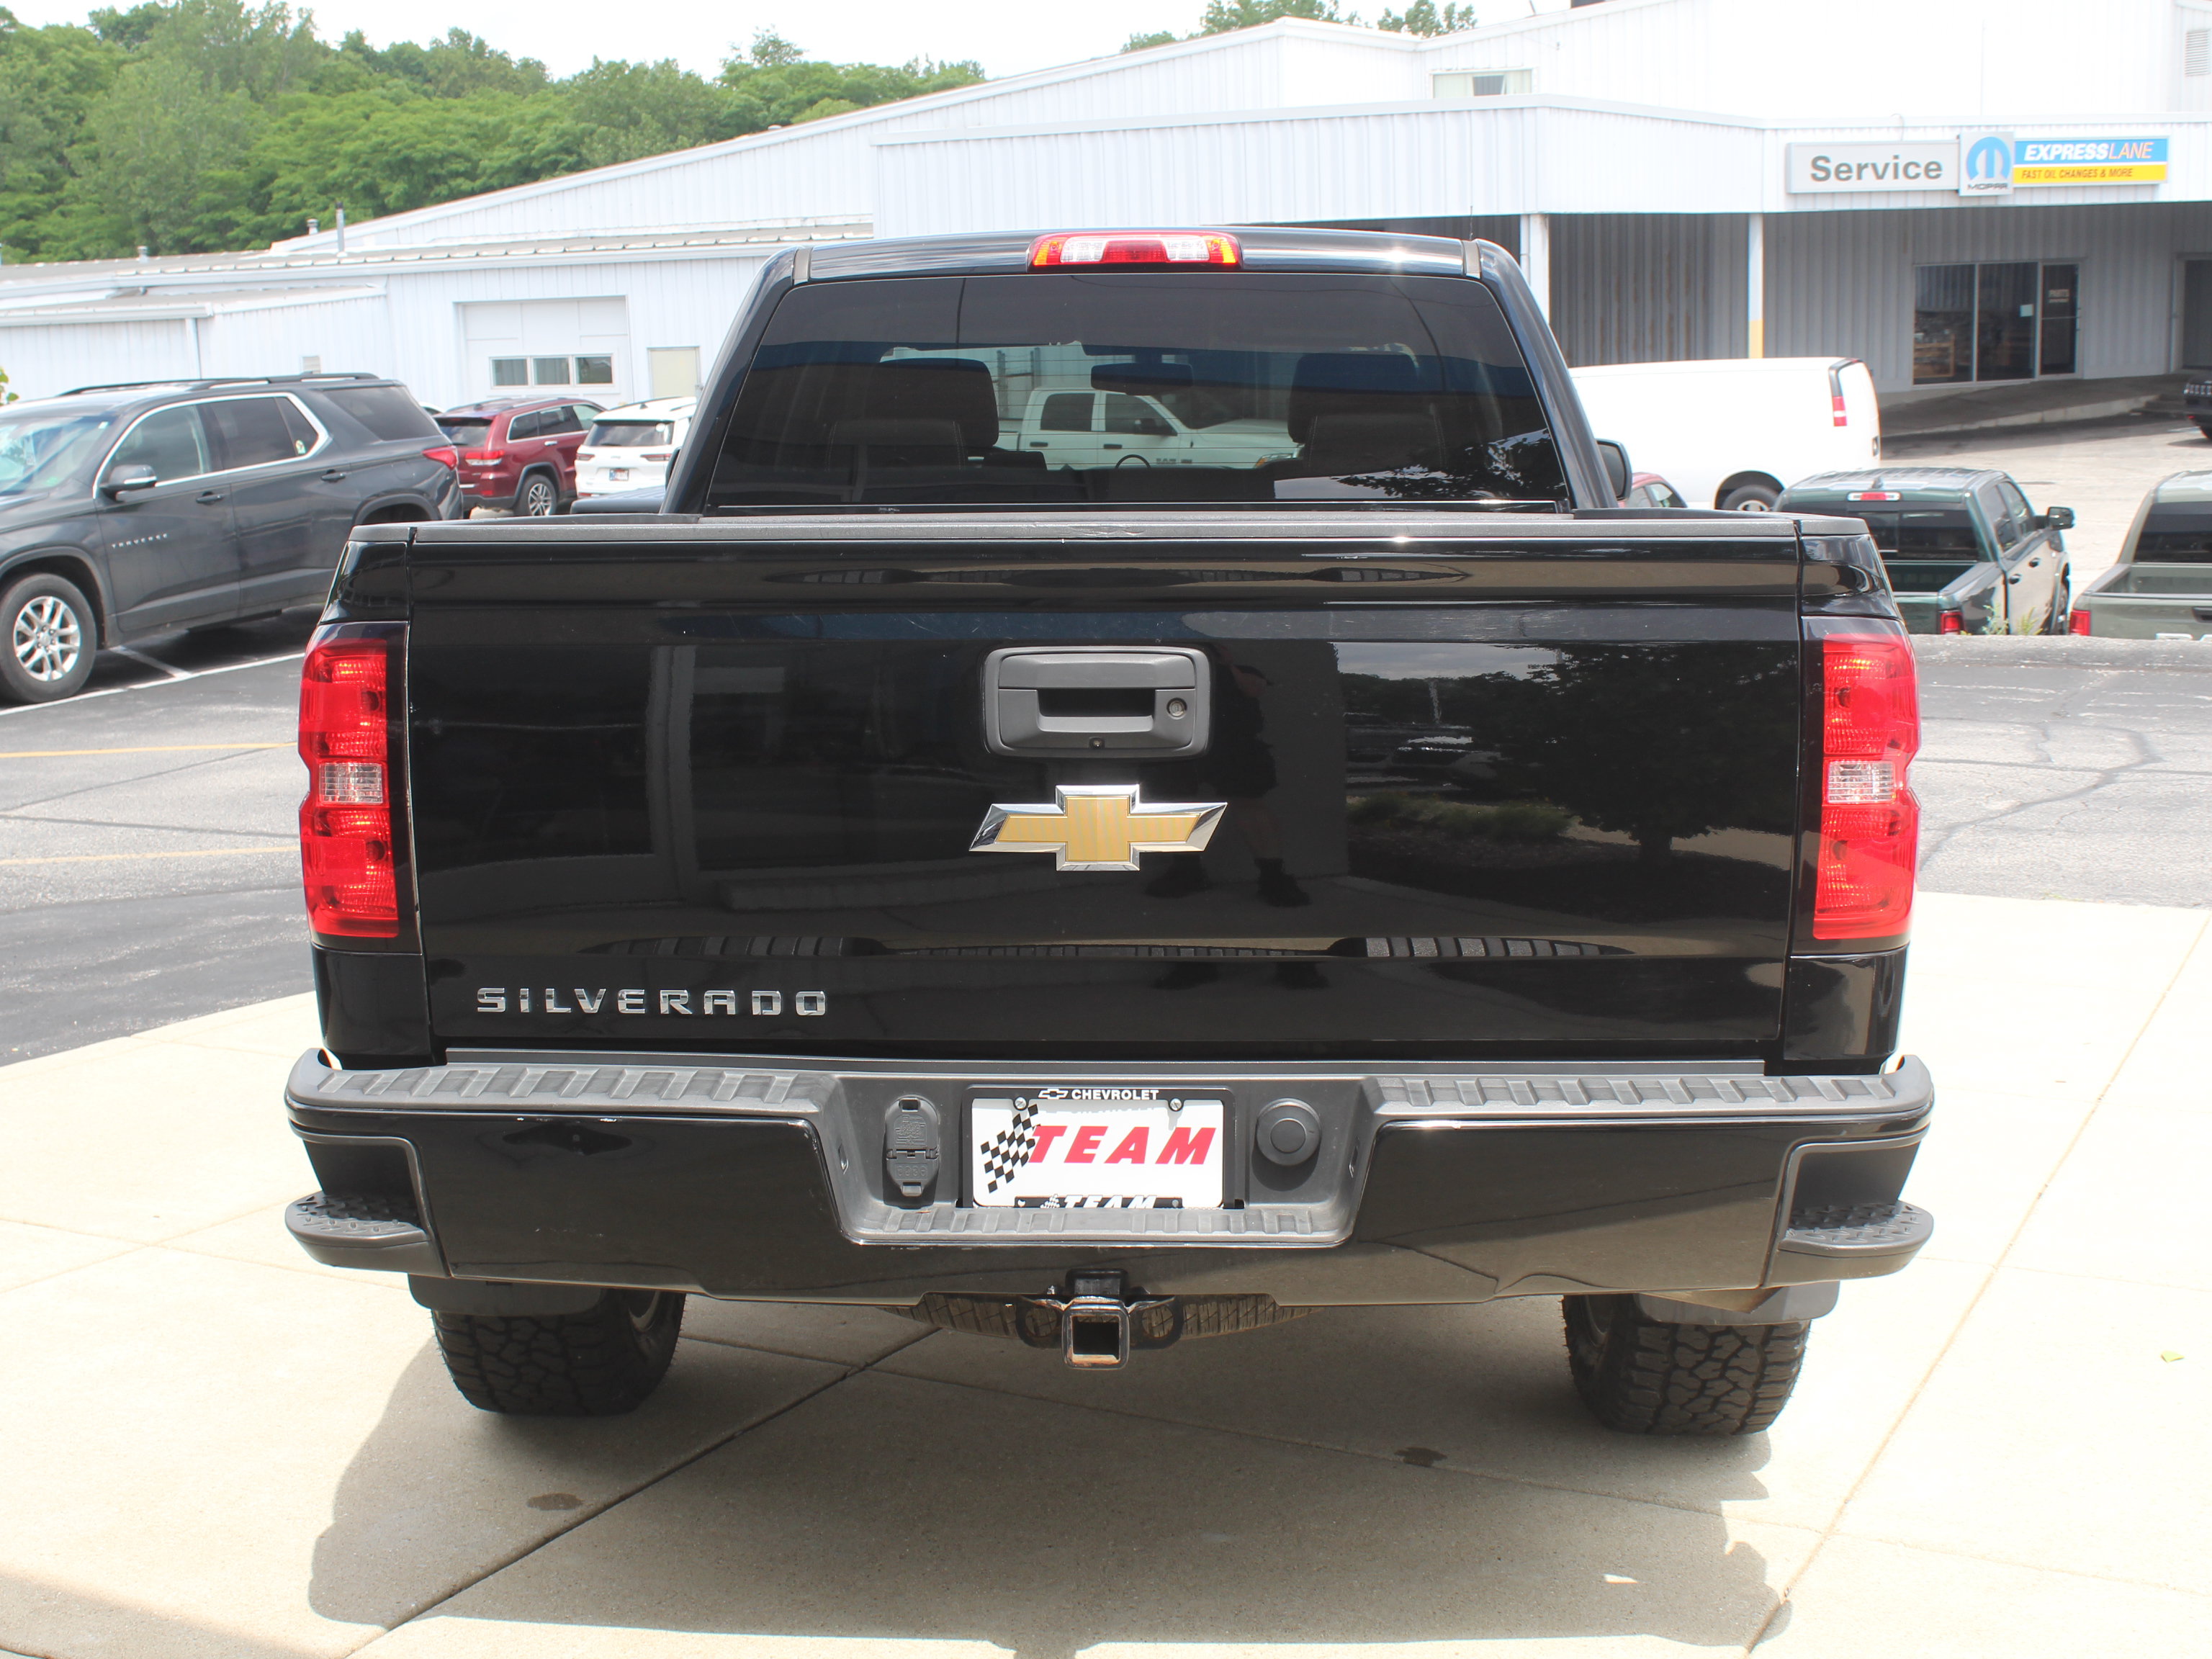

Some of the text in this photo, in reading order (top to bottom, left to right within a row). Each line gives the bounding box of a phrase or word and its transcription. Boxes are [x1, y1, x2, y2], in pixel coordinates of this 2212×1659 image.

[1810, 154, 1943, 181] Service
[2021, 168, 2134, 179] FAST OIL CHANGES & MORE
[477, 987, 826, 1015] SILVERADO
[1071, 1089, 1159, 1100] CHEVROLET
[1028, 1125, 1216, 1164] TEAM
